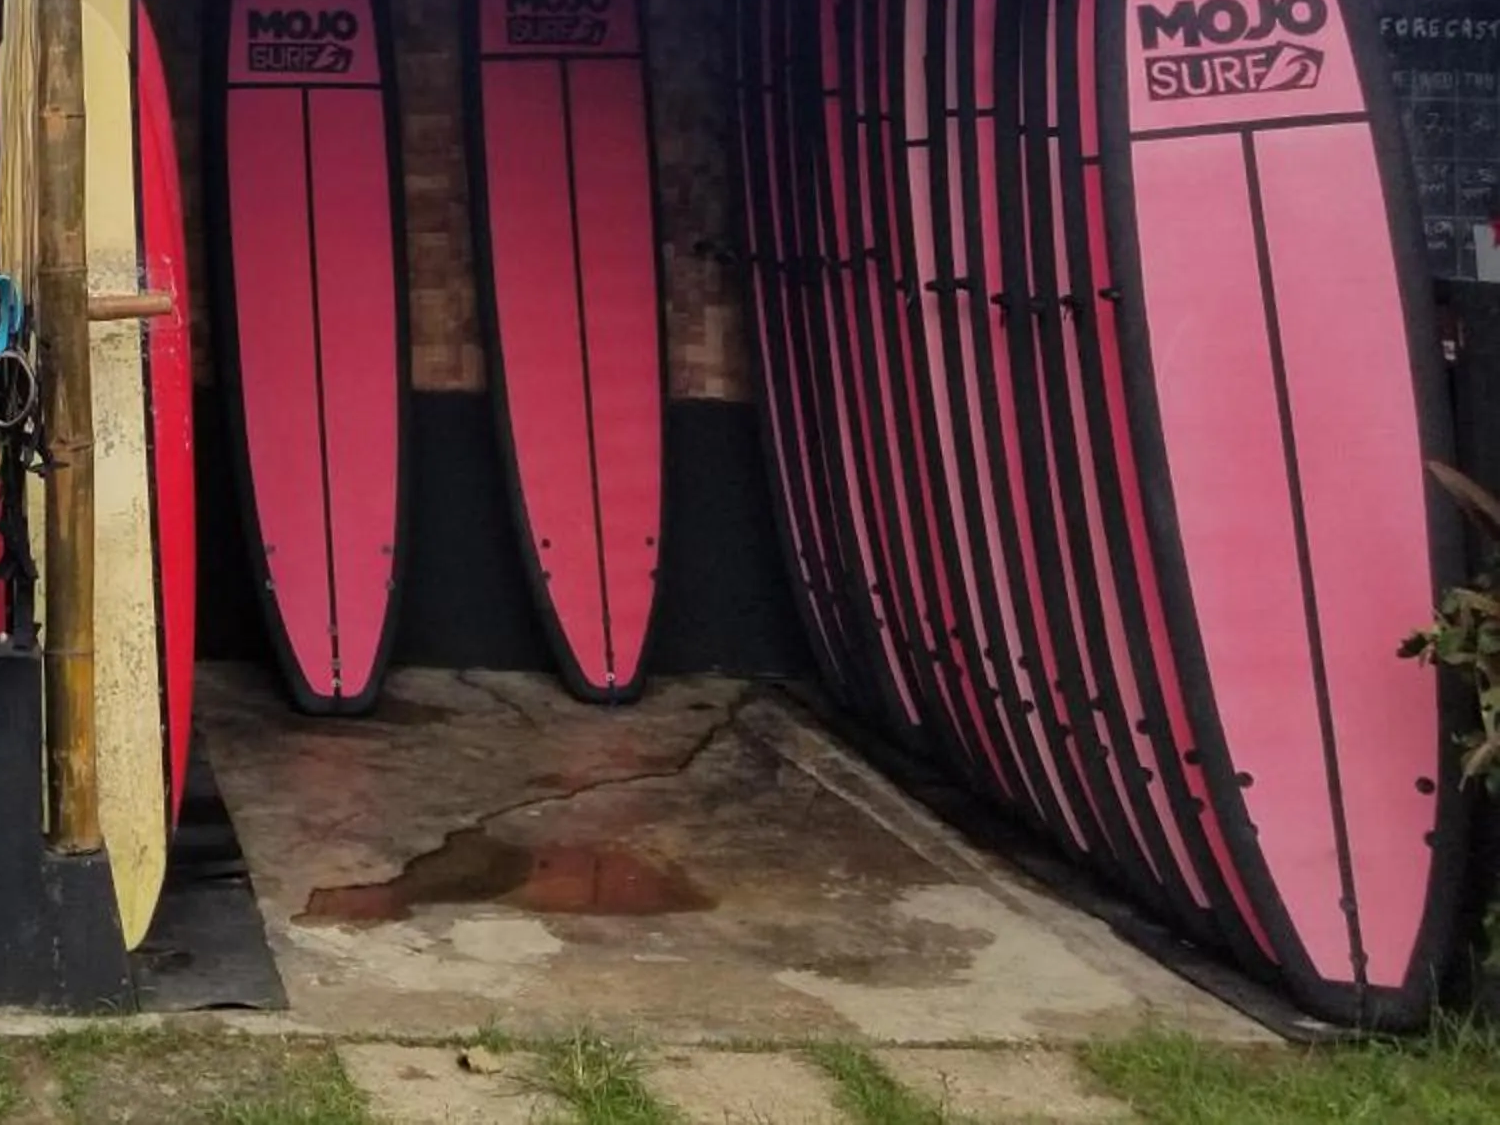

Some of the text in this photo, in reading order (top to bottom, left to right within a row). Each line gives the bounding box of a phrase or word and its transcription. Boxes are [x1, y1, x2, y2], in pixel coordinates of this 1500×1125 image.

[248, 8, 358, 42] MOJO
[510, 17, 574, 44] SURF
[251, 43, 317, 70] SURF
[1150, 52, 1269, 97] SURF
